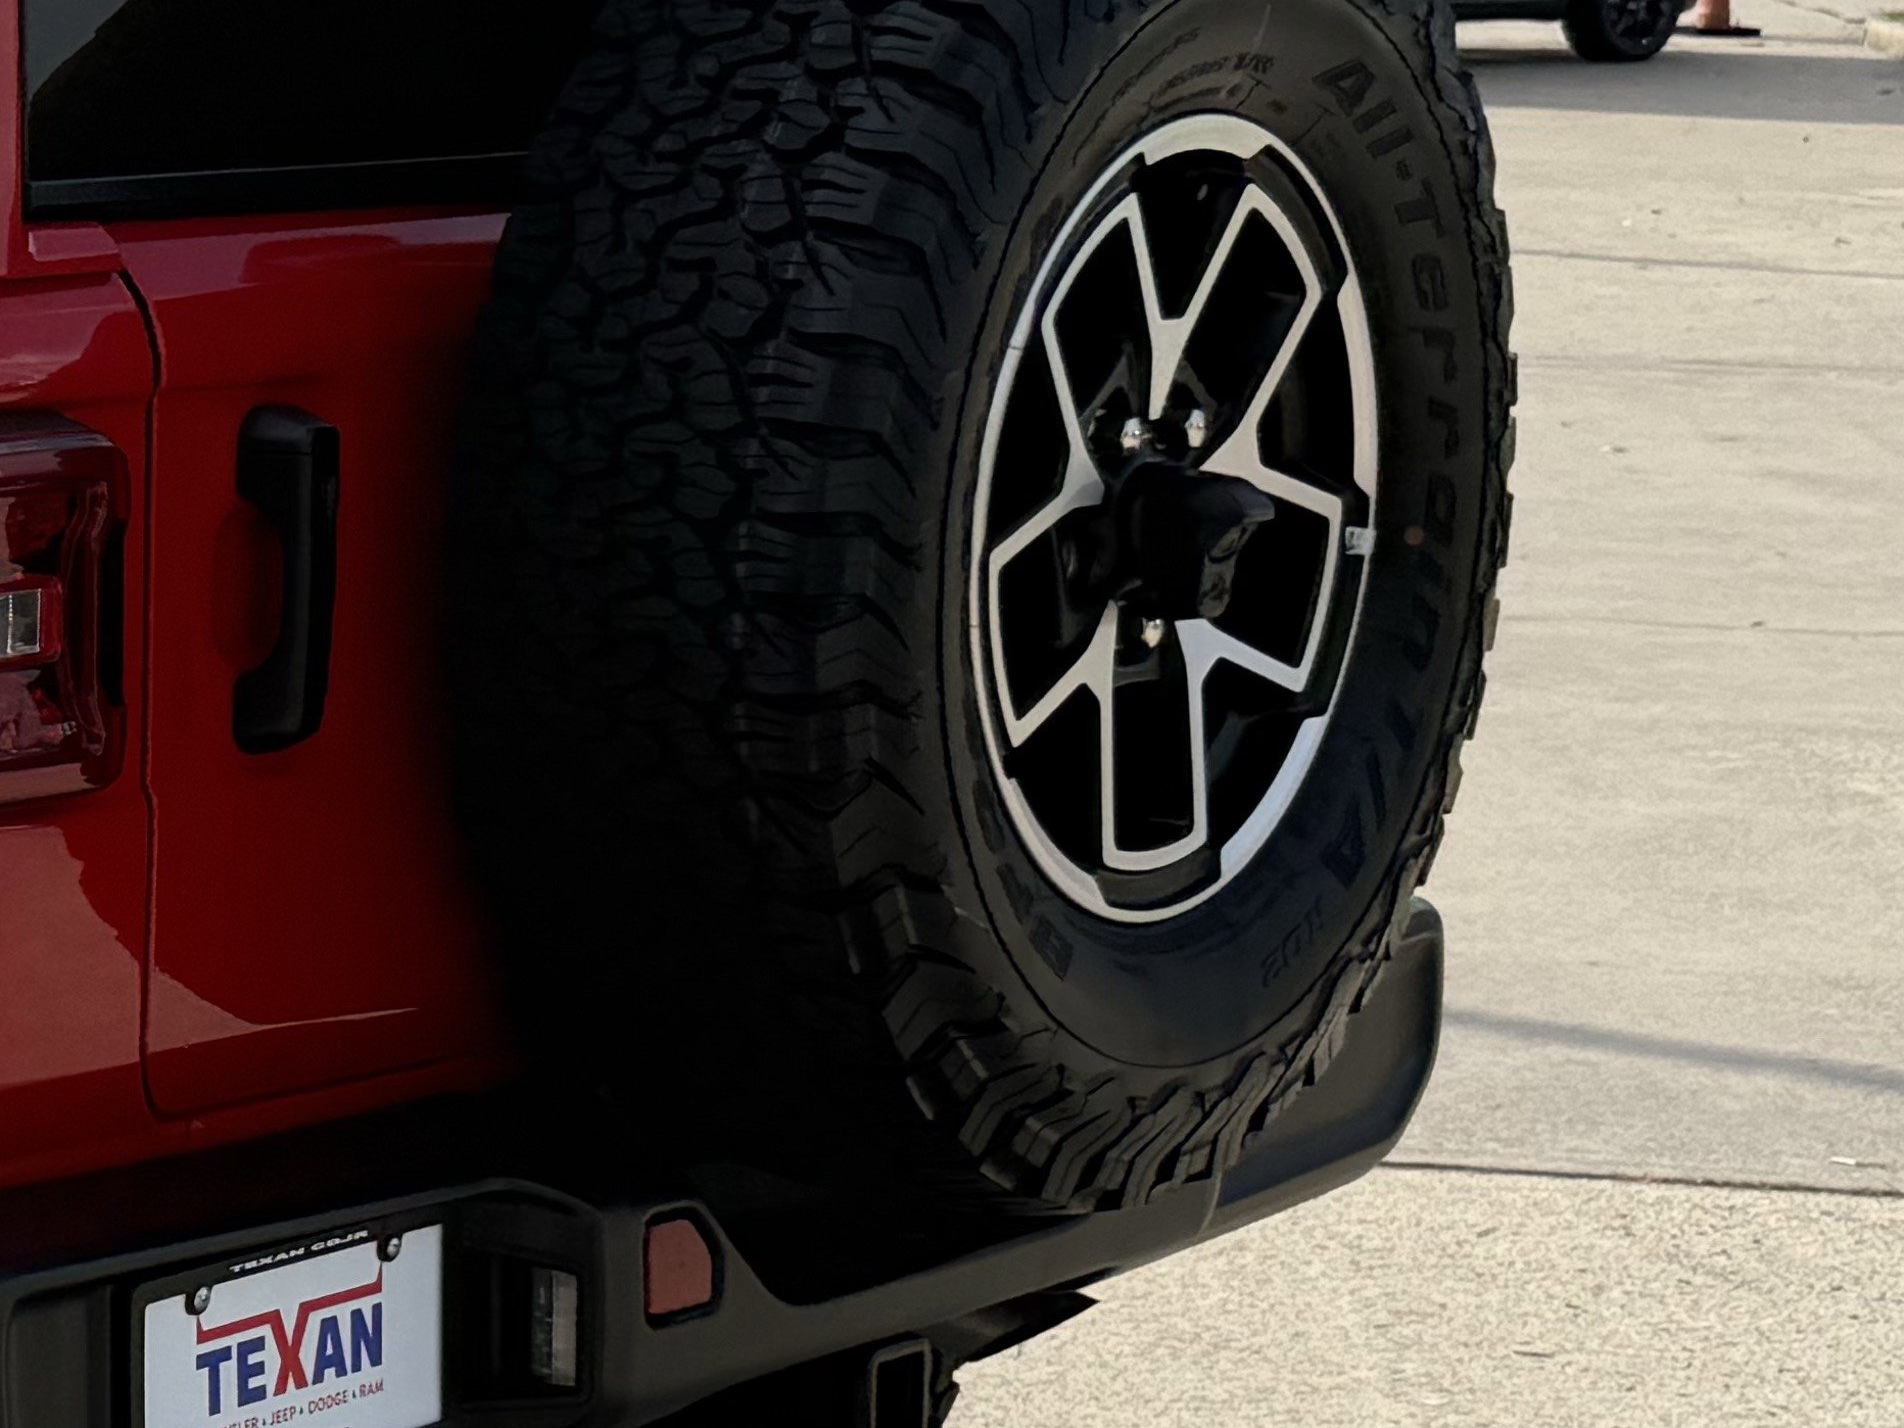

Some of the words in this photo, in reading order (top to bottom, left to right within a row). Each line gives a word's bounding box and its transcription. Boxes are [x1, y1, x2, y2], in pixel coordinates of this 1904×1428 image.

[229, 1247, 305, 1273] TEXAN
[196, 1276, 382, 1416] TEXAN
[270, 1405, 296, 1426] JEEP
[308, 1389, 349, 1414] DODGE
[359, 1378, 384, 1398] RAM
